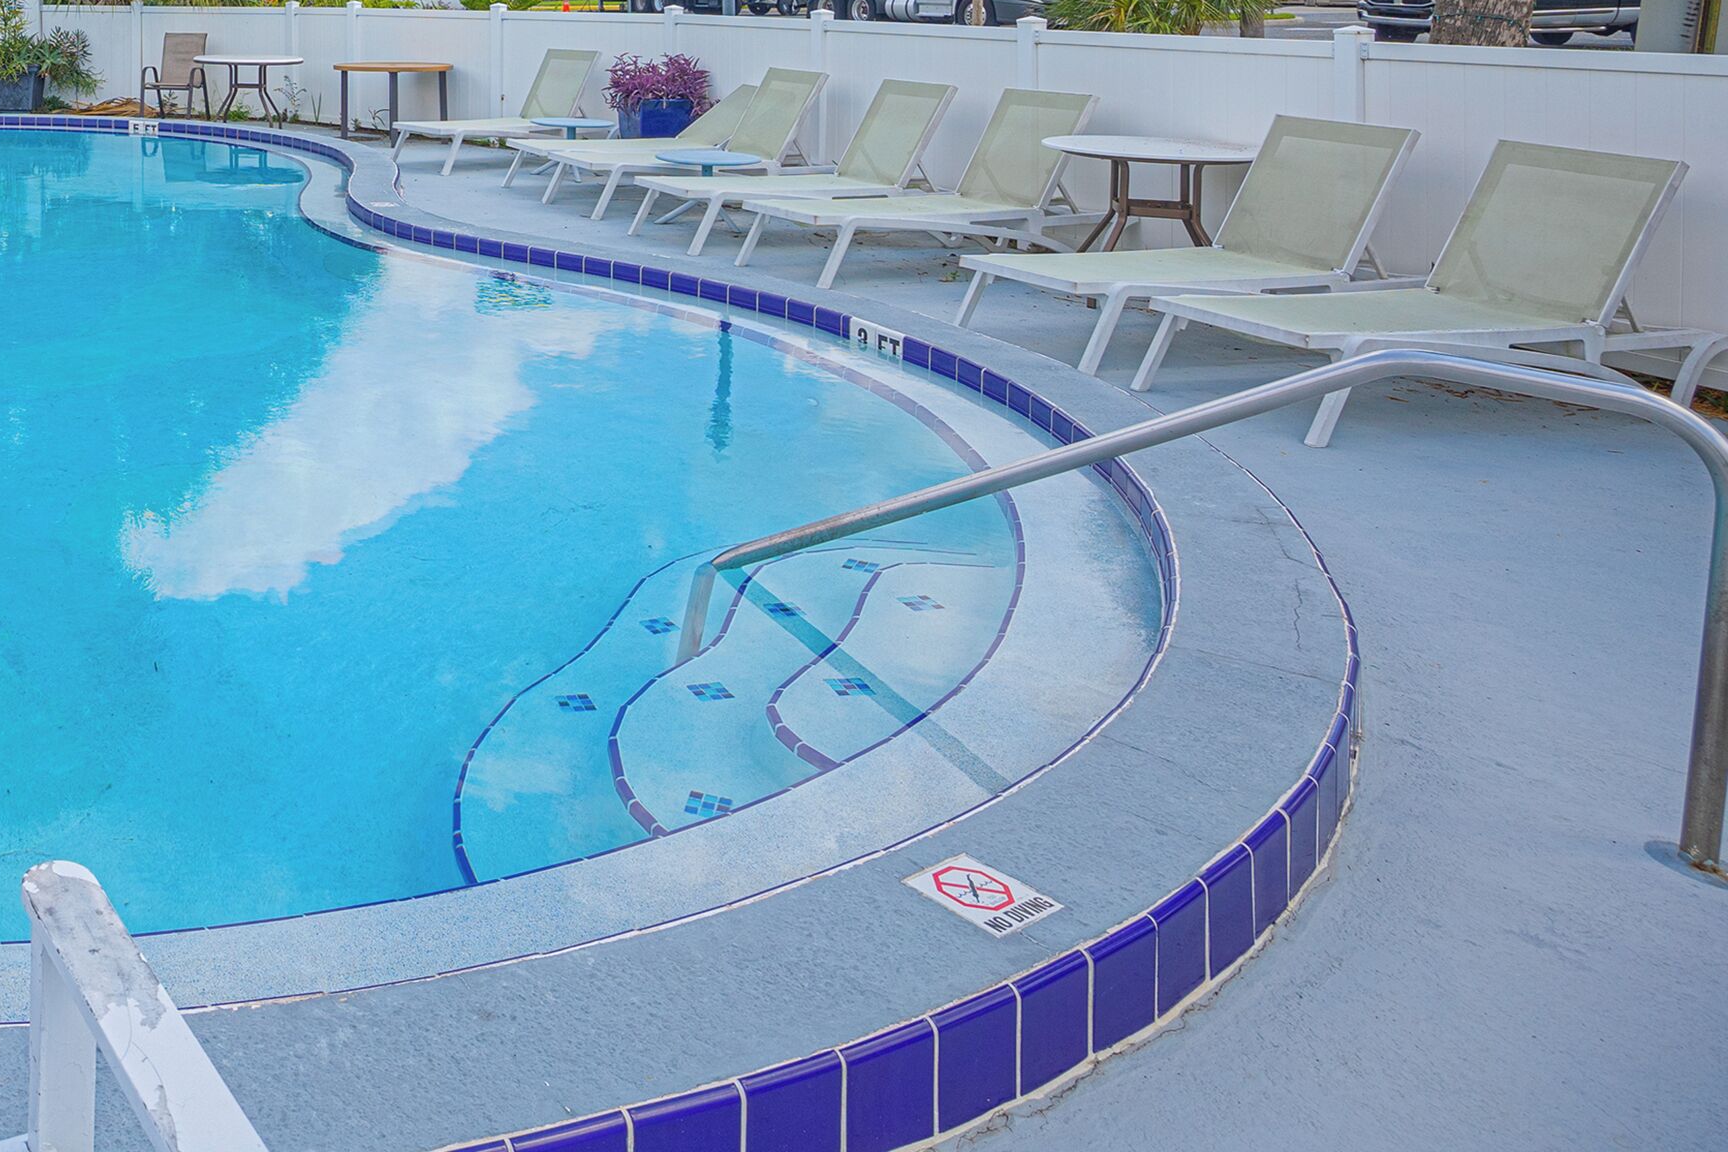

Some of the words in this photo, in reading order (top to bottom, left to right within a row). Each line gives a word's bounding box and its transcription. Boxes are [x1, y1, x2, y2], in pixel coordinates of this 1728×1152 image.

[877, 334, 900, 356] FT
[983, 916, 1014, 933] NO
[1003, 896, 1055, 923] DIVING
